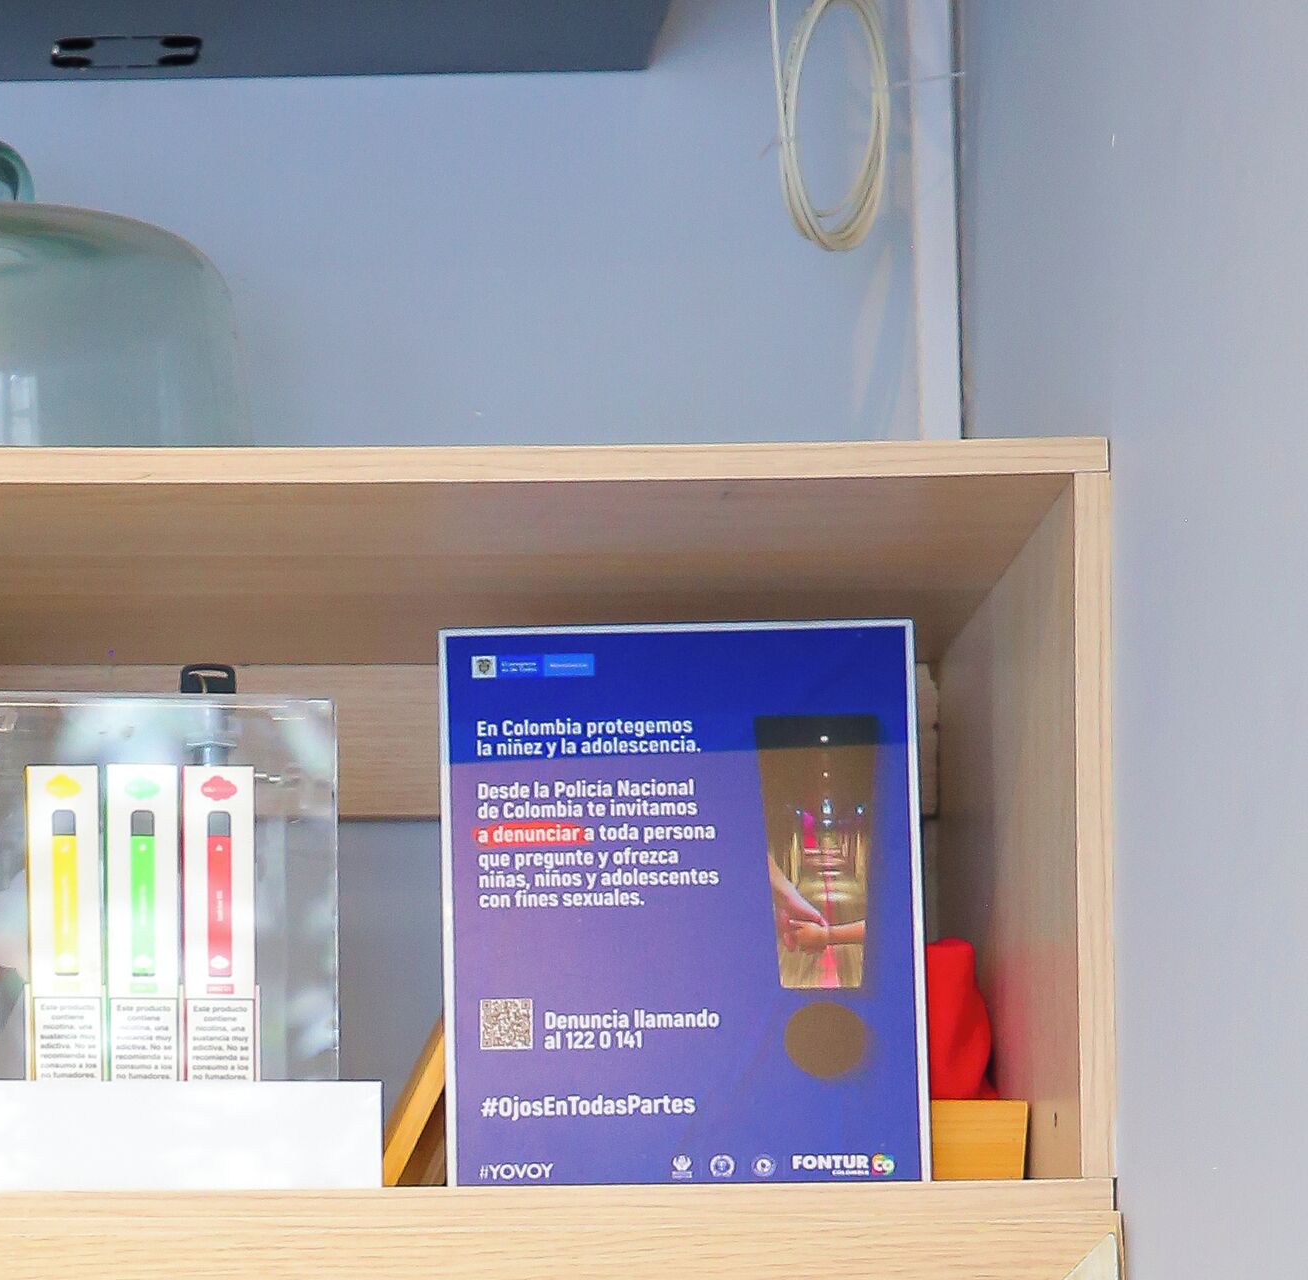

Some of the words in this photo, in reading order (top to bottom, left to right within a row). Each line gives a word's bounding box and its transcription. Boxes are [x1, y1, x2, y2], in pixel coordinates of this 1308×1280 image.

[477, 721, 497, 735] En
[502, 719, 581, 735] Colombia
[587, 718, 692, 738] protegemos
[477, 740, 491, 756] la
[497, 738, 543, 755] niñez
[546, 742, 556, 758] y
[561, 739, 576, 754] la
[581, 738, 701, 753] adolescencia.
[478, 783, 529, 798] Desde
[534, 782, 550, 798] la
[555, 780, 612, 797] Policía
[617, 779, 693, 796] Nacional
[478, 803, 498, 819] de
[504, 801, 583, 818] Colombia
[587, 801, 605, 817] te
[610, 800, 697, 816] invitamos
[478, 830, 488, 843] a
[493, 826, 580, 843] denunciar
[584, 829, 594, 841] a
[599, 825, 638, 840] toda
[644, 826, 714, 843] persona
[479, 853, 509, 870] que
[515, 851, 593, 869] pregunte
[598, 852, 608, 867] y
[613, 849, 677, 865] ofrezca
[479, 872, 531, 890] niñas,
[535, 870, 582, 887] niños
[586, 873, 596, 887] y
[601, 868, 718, 886] adolescentes
[480, 894, 509, 908] con
[515, 891, 558, 907] fines
[563, 890, 645, 907] sexuales.
[545, 1011, 629, 1030] Denuncia
[634, 1009, 719, 1028] llamando
[545, 1033, 561, 1049] al
[567, 1032, 595, 1048] 122
[616, 1031, 642, 1047] 141
[481, 1097, 695, 1121] #OjosEnTodasPartes
[479, 1163, 553, 1180] #YOVOY
[793, 1155, 868, 1170] FONTUR
